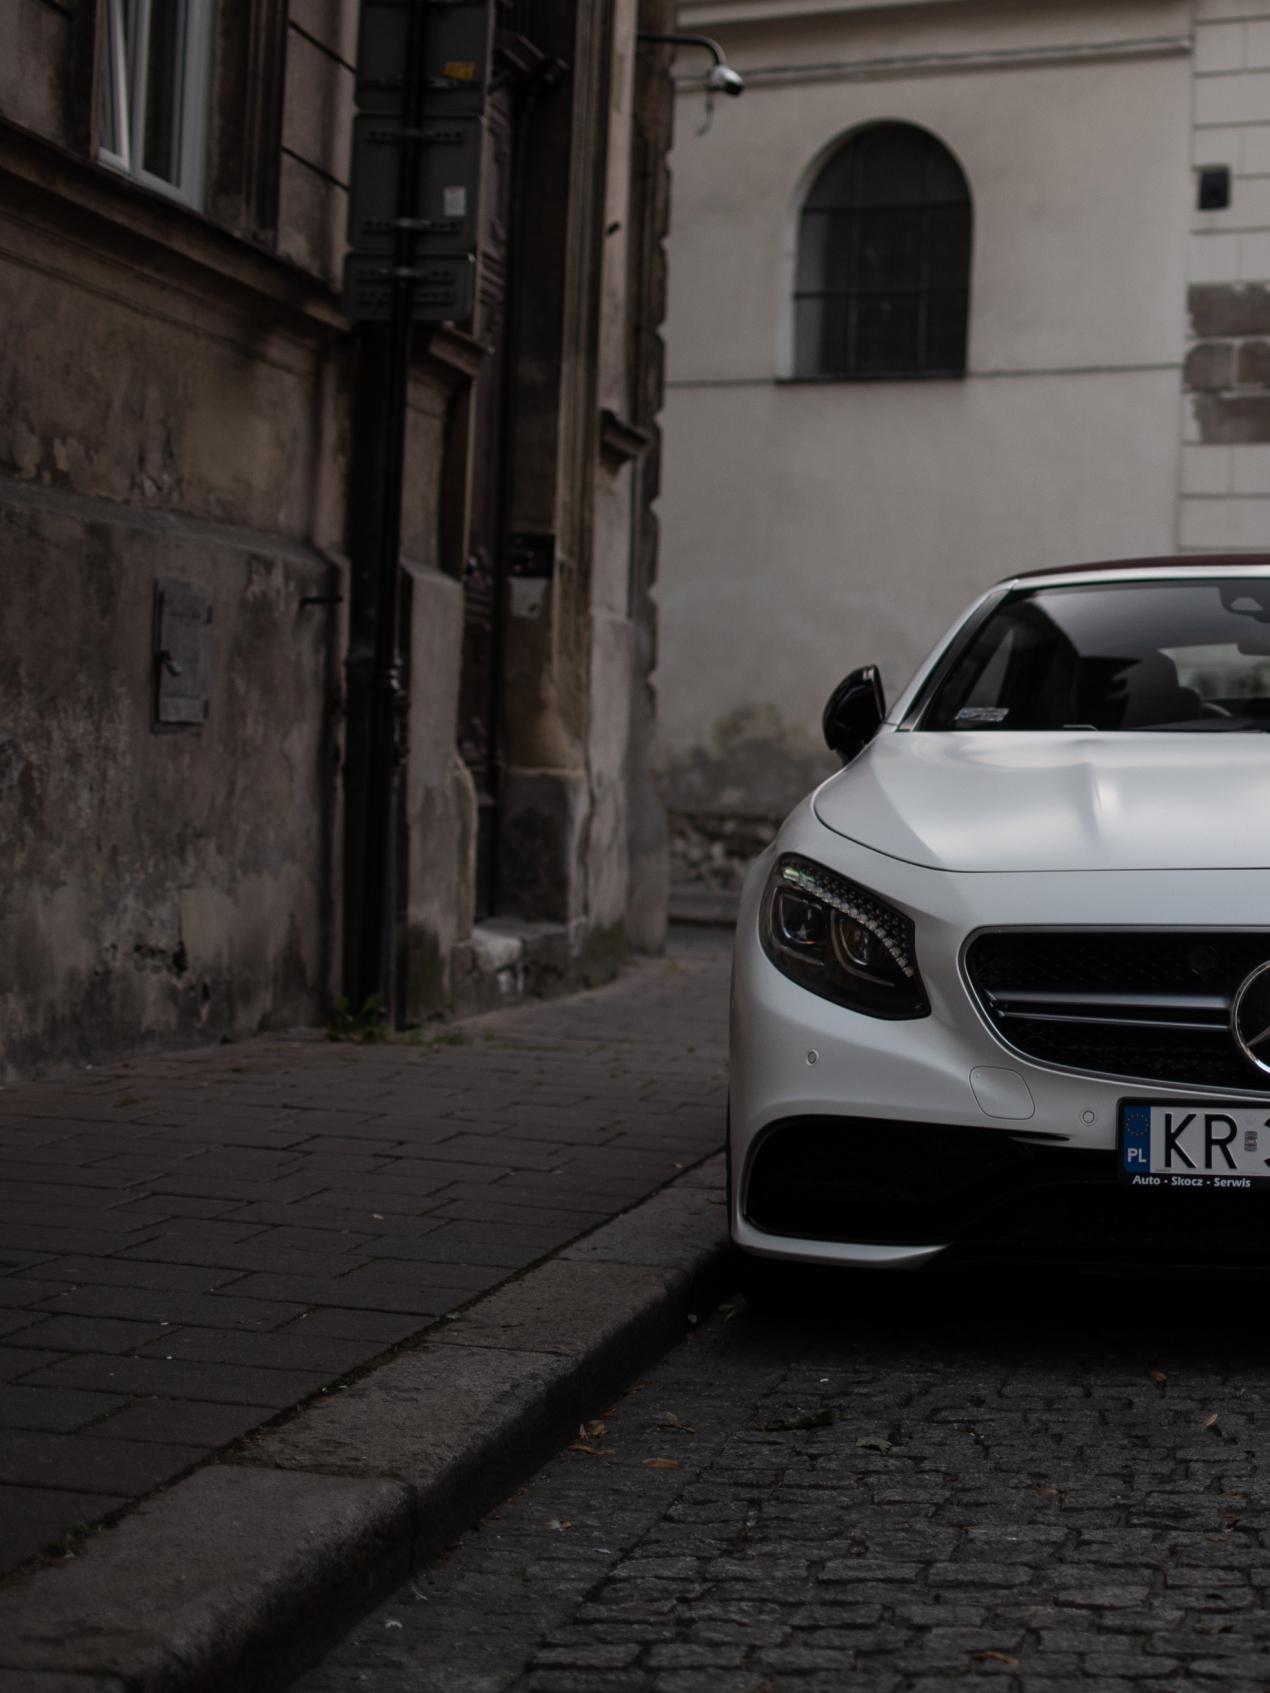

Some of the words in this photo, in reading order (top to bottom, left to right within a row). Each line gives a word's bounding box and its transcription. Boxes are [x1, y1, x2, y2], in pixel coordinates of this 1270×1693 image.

[1165, 1113, 1238, 1170] KR
[1127, 1148, 1147, 1163] PL
[1132, 1175, 1161, 1187] Auto
[1171, 1176, 1203, 1188] Skocz
[1213, 1177, 1251, 1188] Serwis
